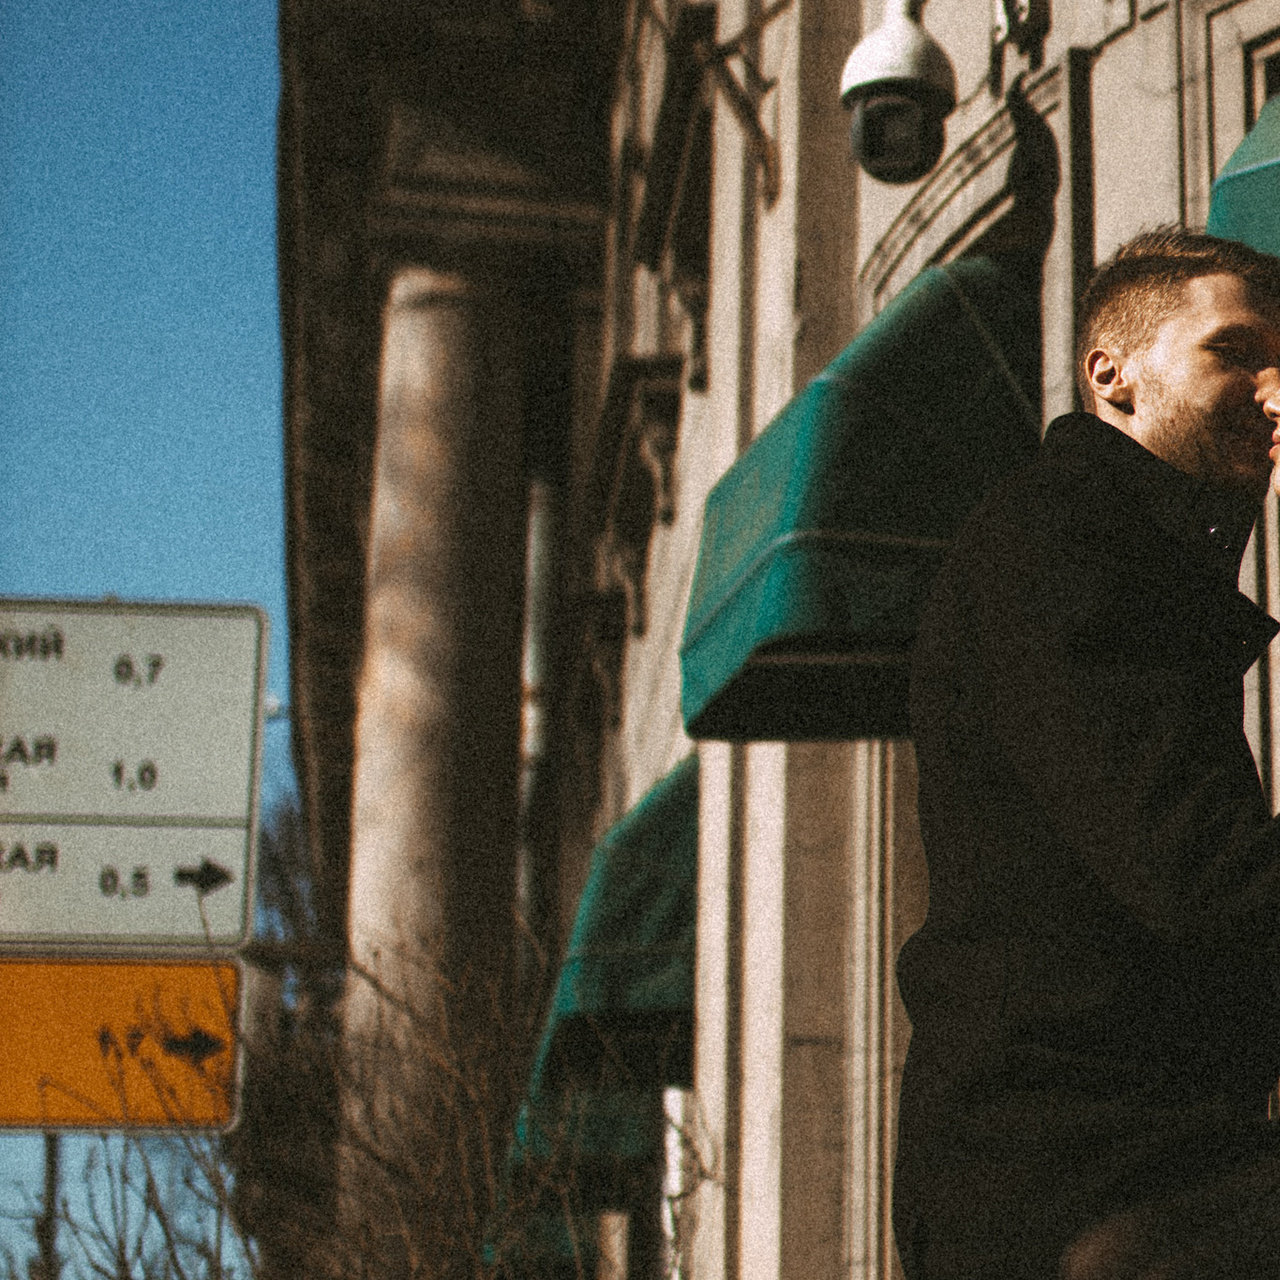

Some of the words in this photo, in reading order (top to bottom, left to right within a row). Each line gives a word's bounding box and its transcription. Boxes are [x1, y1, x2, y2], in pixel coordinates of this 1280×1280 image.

[113, 653, 163, 689] 0,7
[0, 735, 58, 767] АЯ
[0, 841, 59, 874] АЯ
